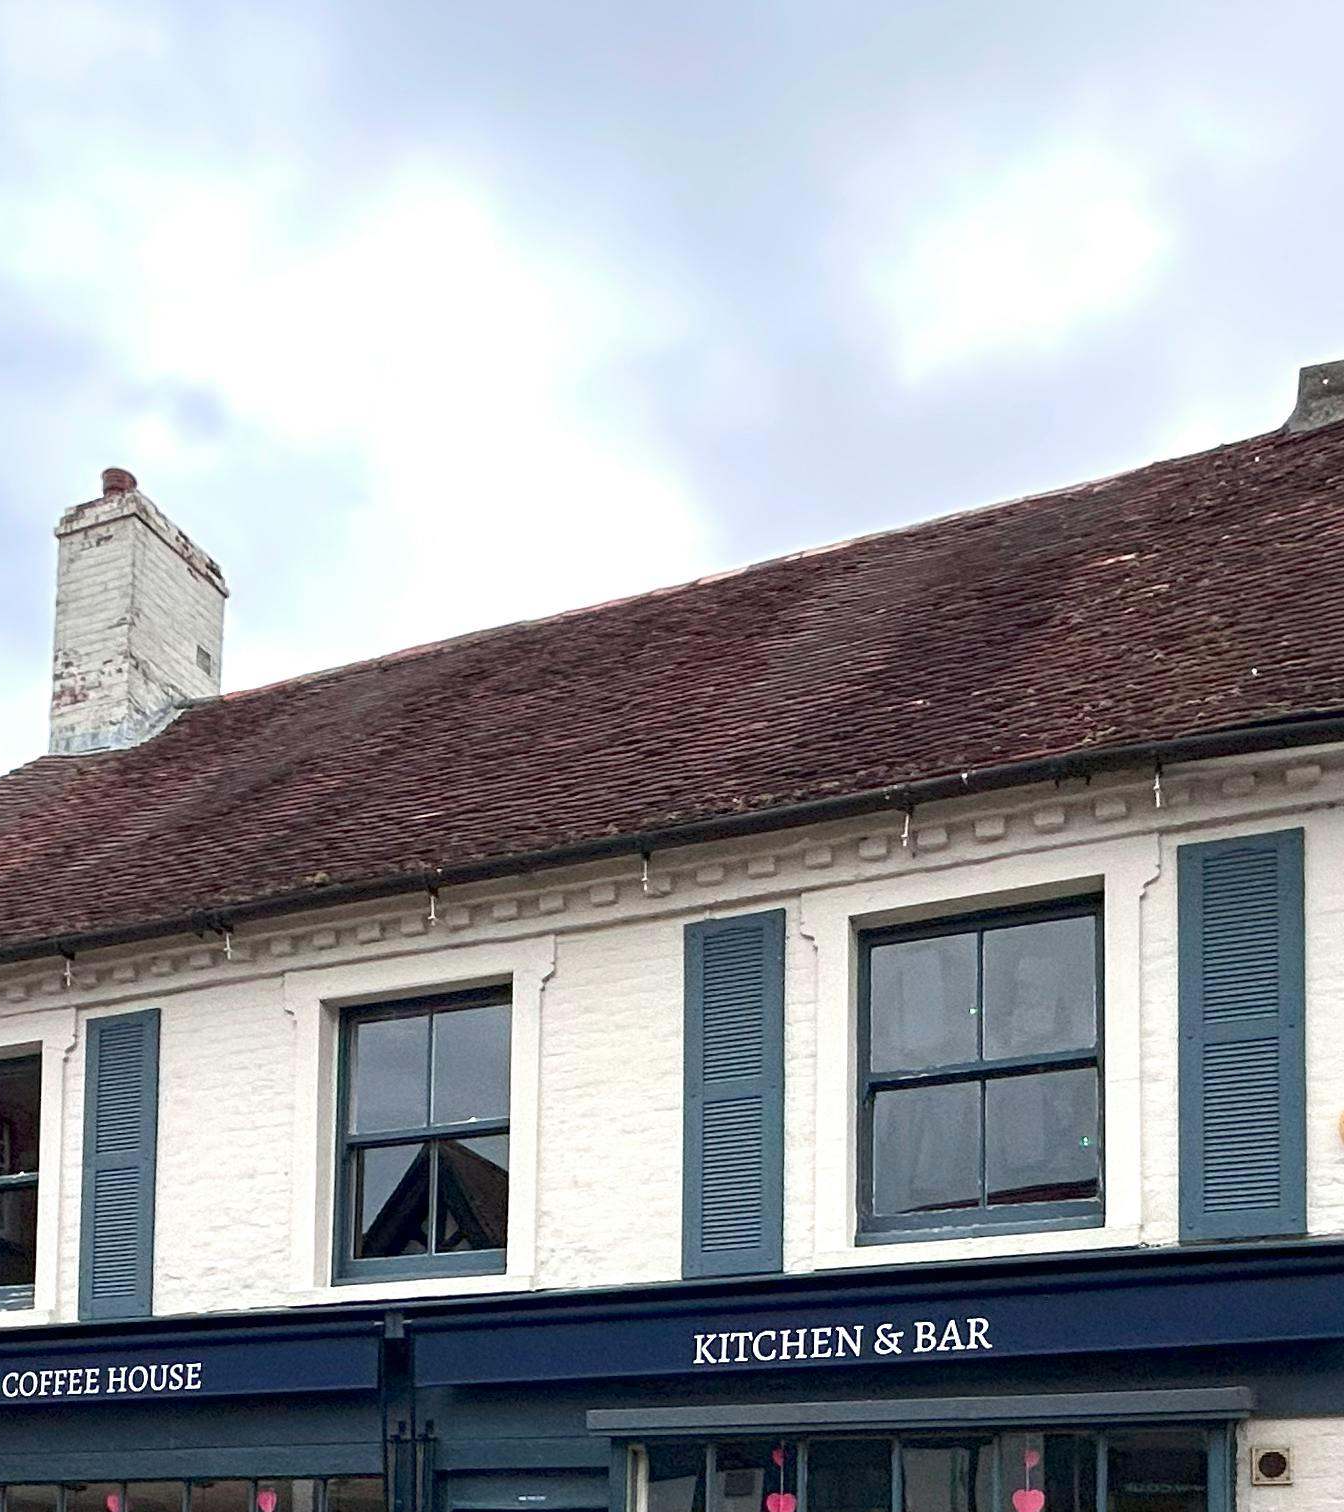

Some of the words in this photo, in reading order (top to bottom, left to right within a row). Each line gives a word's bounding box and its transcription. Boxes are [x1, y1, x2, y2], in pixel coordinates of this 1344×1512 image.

[693, 1325, 864, 1364] KITCHEN
[874, 1323, 904, 1355] &
[913, 1317, 993, 1353] BAR
[2, 1368, 99, 1397] COFFEE
[106, 1362, 202, 1393] HOUSE
